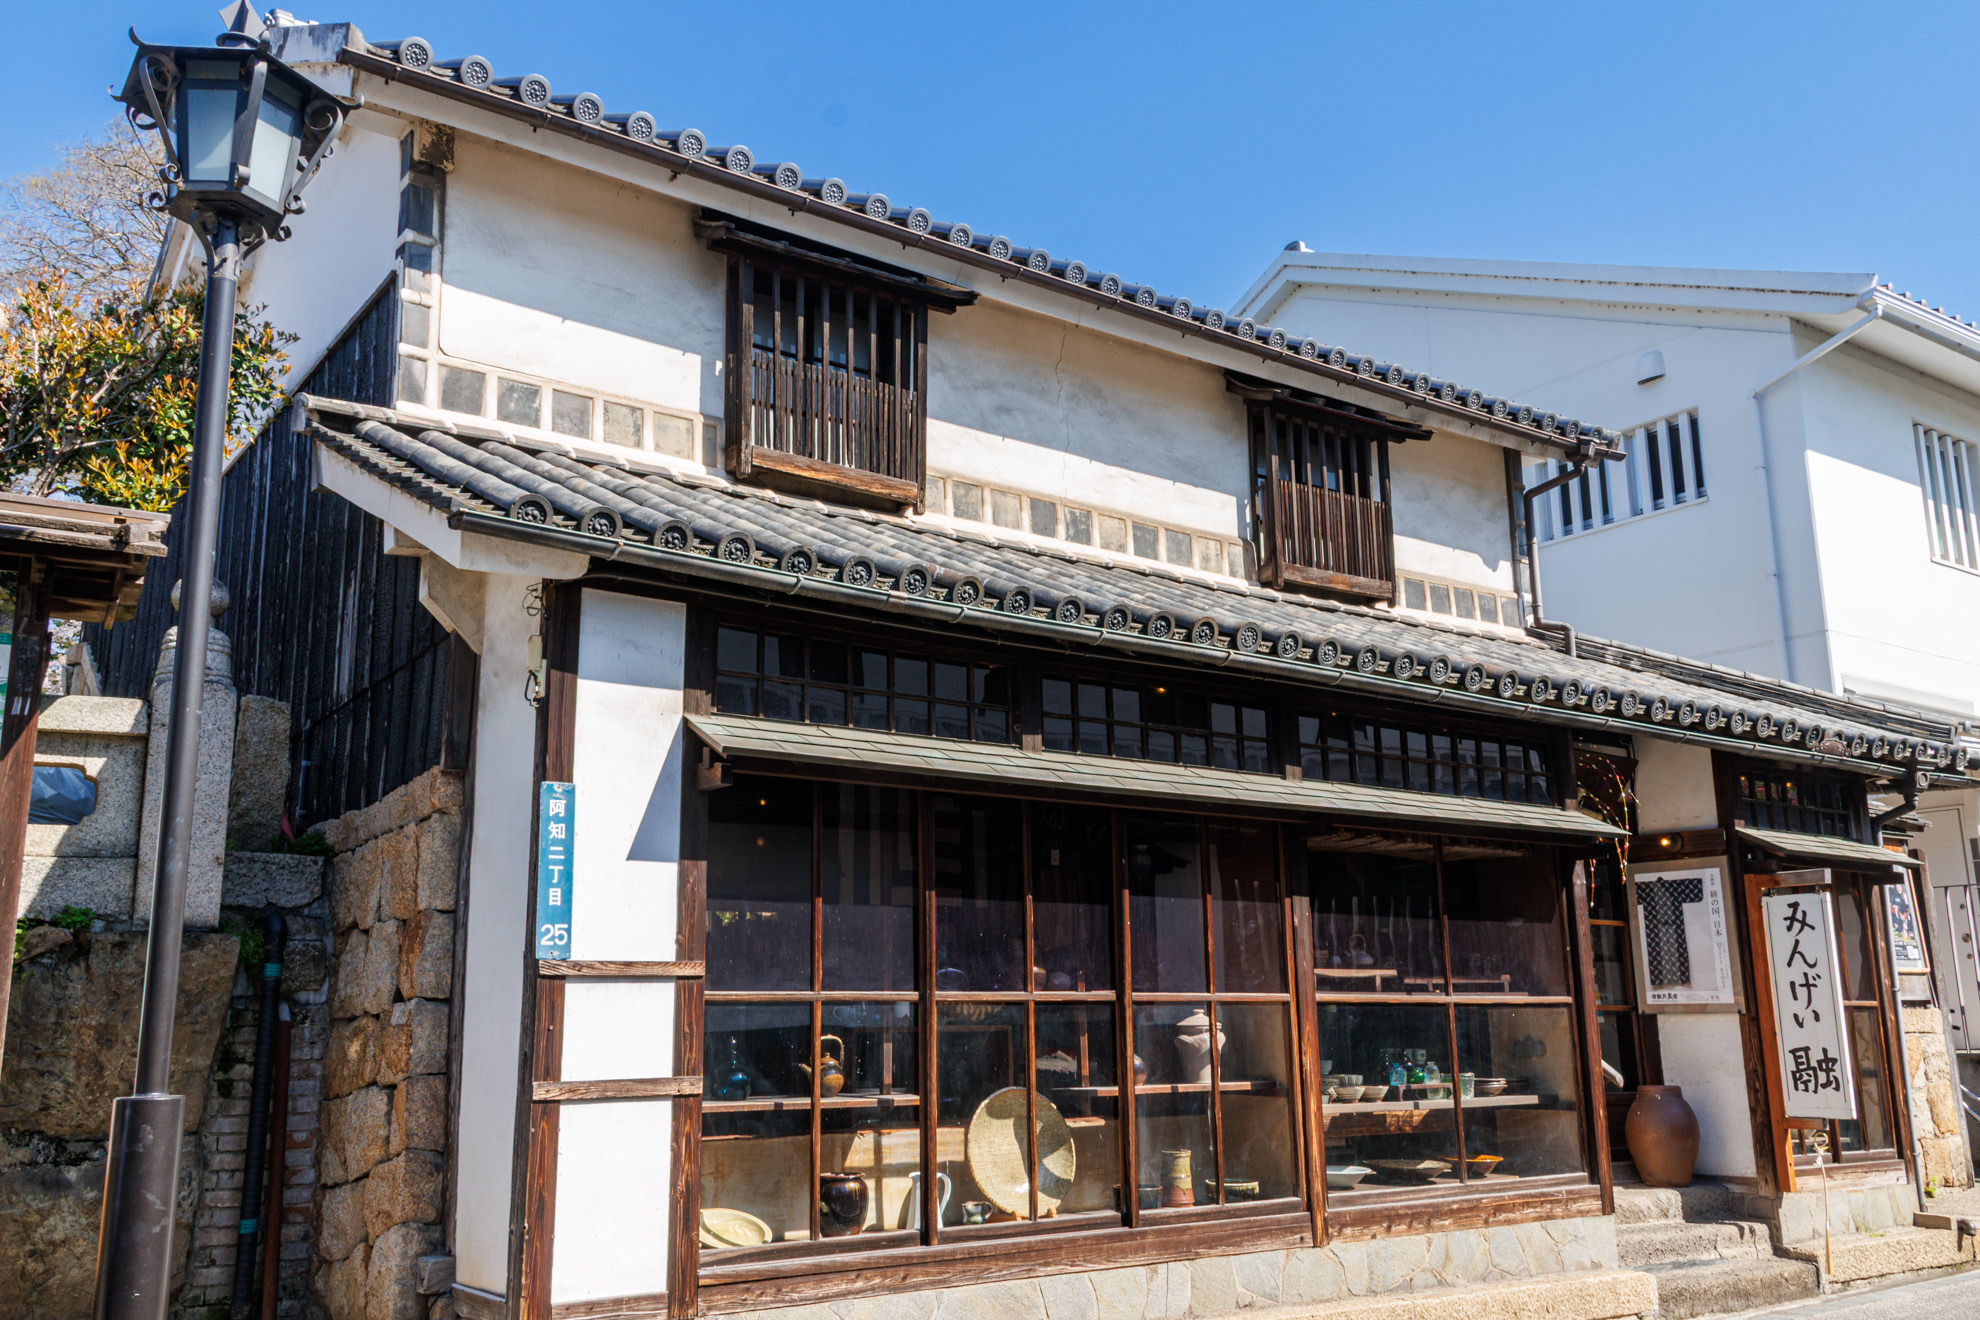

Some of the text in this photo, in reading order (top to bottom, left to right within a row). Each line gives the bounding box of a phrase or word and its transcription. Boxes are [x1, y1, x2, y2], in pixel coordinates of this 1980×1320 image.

[540, 799, 569, 946] 阿知二丁目 25
[1783, 901, 1841, 1094] みんげい 融
